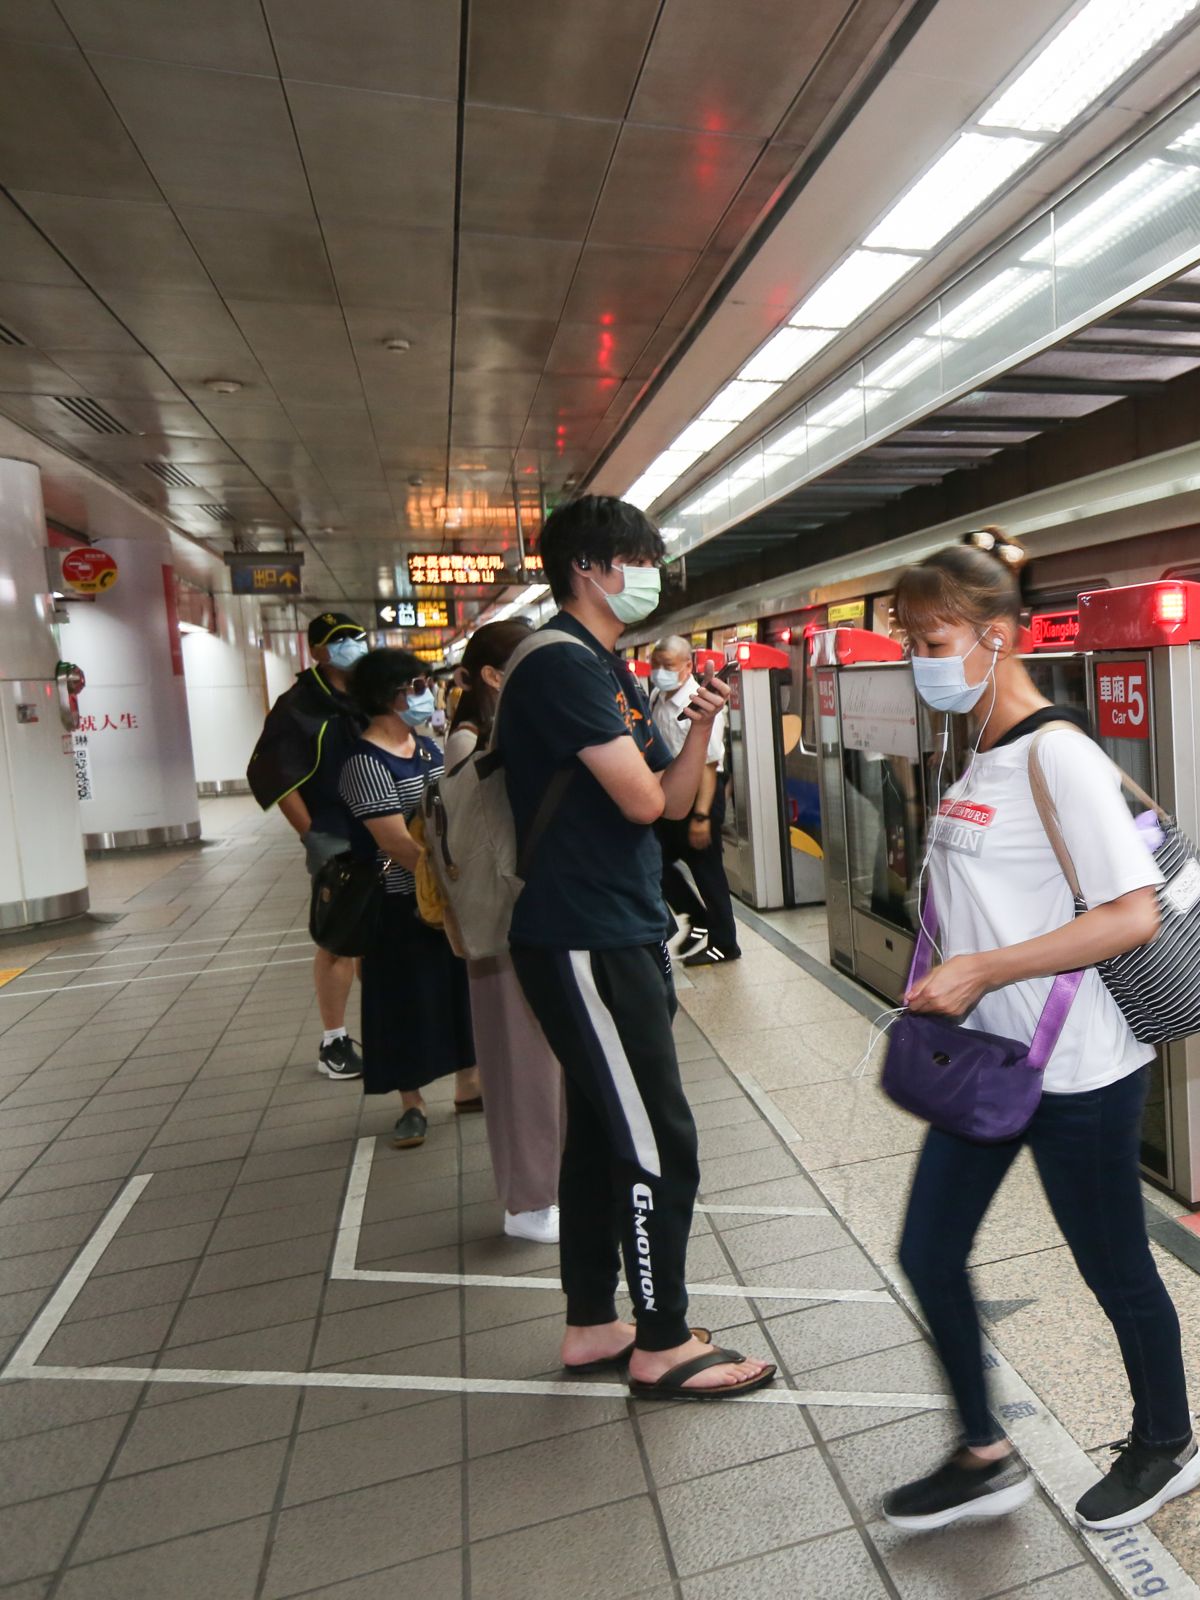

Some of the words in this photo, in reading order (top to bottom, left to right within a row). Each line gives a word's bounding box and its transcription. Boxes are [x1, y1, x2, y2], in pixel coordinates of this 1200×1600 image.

[1100, 675, 1125, 703] 車廂
[1127, 676, 1144, 726] 5
[1112, 710, 1126, 724] Car
[633, 1183, 658, 1311] G-MOTION
[1100, 1526, 1170, 1598] iting
